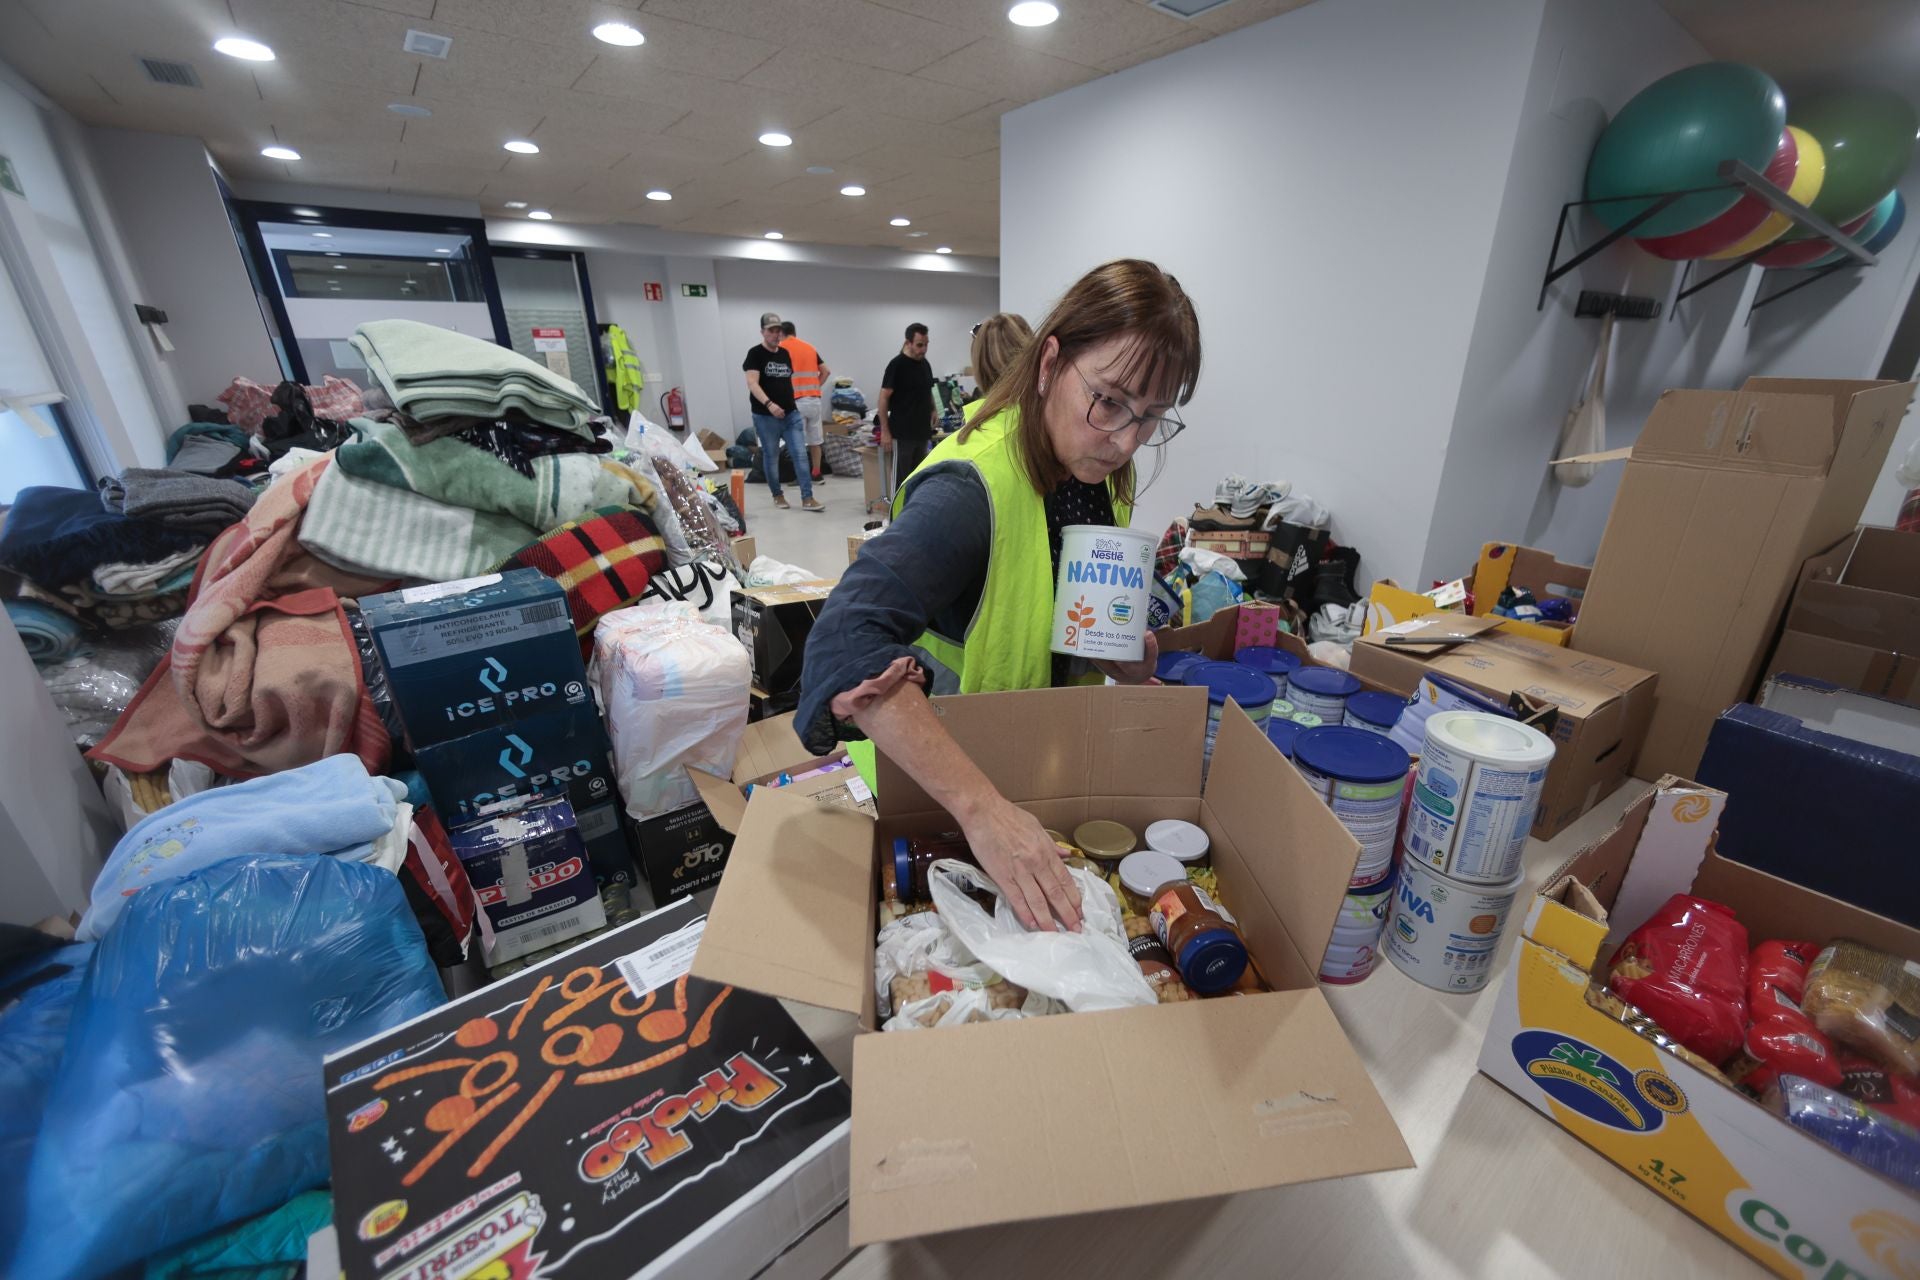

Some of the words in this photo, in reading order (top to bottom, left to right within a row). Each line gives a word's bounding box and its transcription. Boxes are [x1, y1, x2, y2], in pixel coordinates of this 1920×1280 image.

[1067, 560, 1144, 589] NATIVA
[433, 610, 512, 631] ANTICONGELANTE
[441, 620, 505, 638] REFRIGERANTE
[495, 625, 519, 637] ROSA
[1085, 629, 1104, 638] Desde
[1064, 626, 1077, 647] 2
[445, 697, 496, 722] ICE
[505, 682, 557, 706] PRO
[530, 759, 592, 794] PRO
[480, 864, 576, 904] PADO
[670, 880, 700, 895] EUROPE
[701, 875, 710, 884] IN
[1668, 922, 1706, 984] MACARRONES
[1540, 1063, 1574, 1079] Plátano
[1575, 1072, 1587, 1083] de
[1590, 1079, 1630, 1114] Canarias
[603, 1168, 630, 1190] mix
[1637, 1164, 1651, 1177] kg
[1653, 1174, 1687, 1201] NETOS
[1648, 1158, 1688, 1186] 17
[602, 1171, 641, 1205] party
